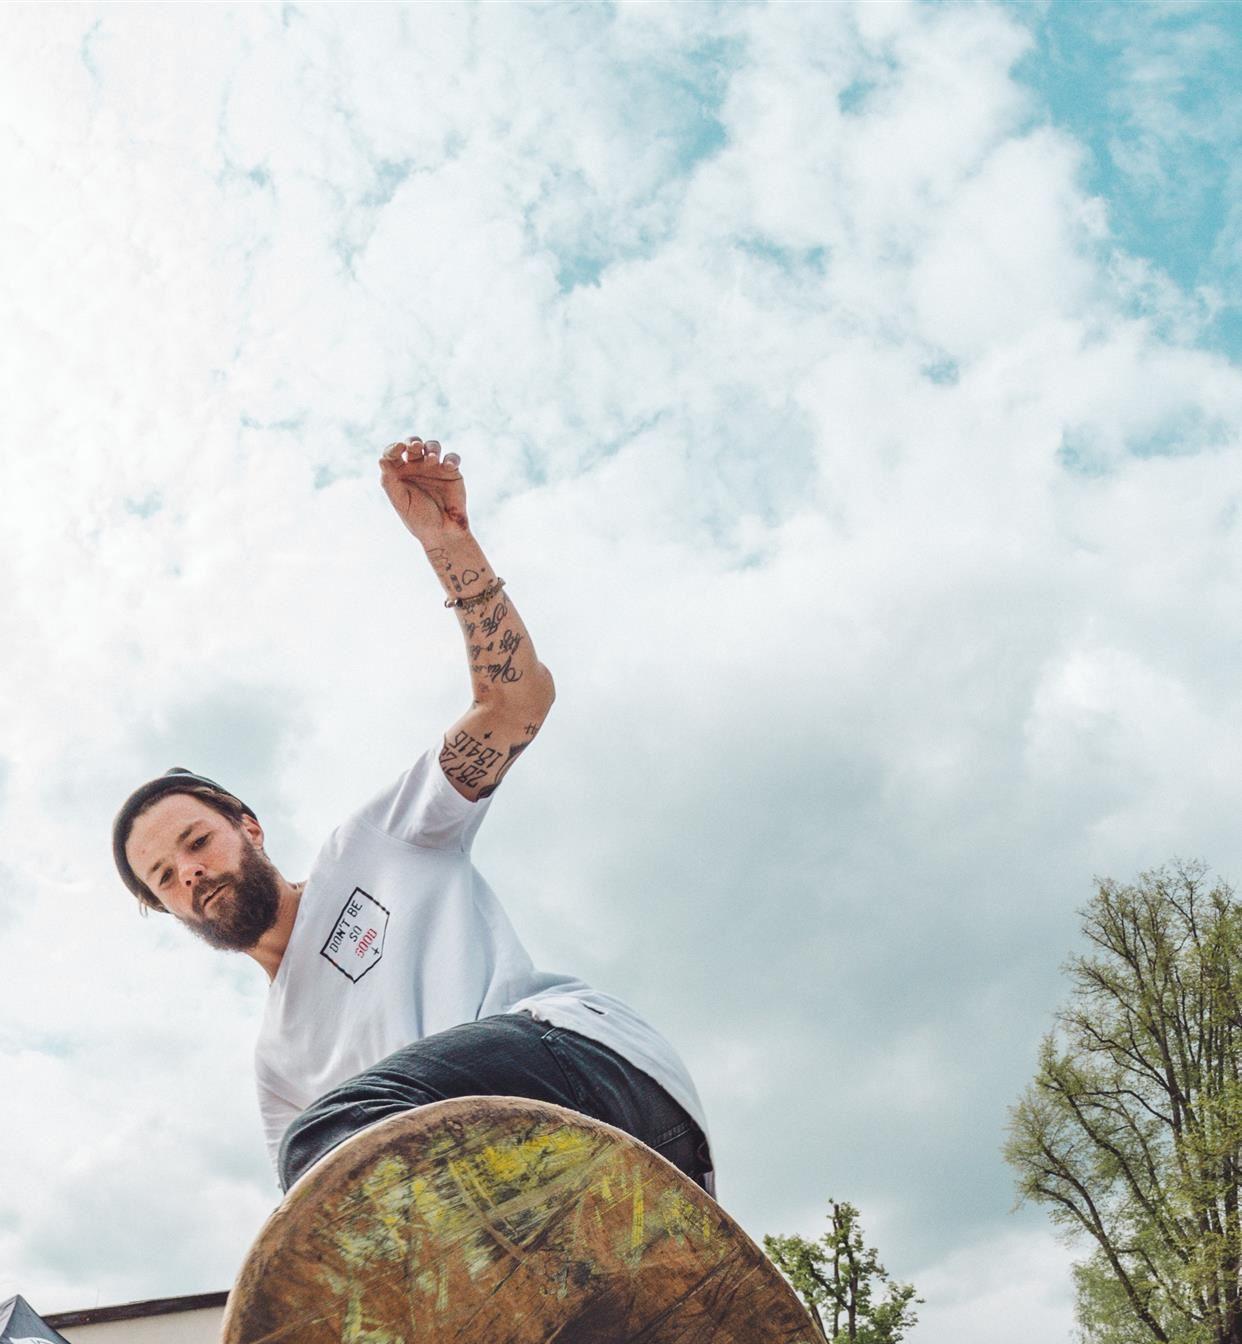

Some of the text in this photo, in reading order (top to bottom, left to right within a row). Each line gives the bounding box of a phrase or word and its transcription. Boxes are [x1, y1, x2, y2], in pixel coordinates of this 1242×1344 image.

[329, 899, 363, 953] DON'T BE
[349, 925, 363, 942] SO
[355, 928, 378, 958] GOOD
